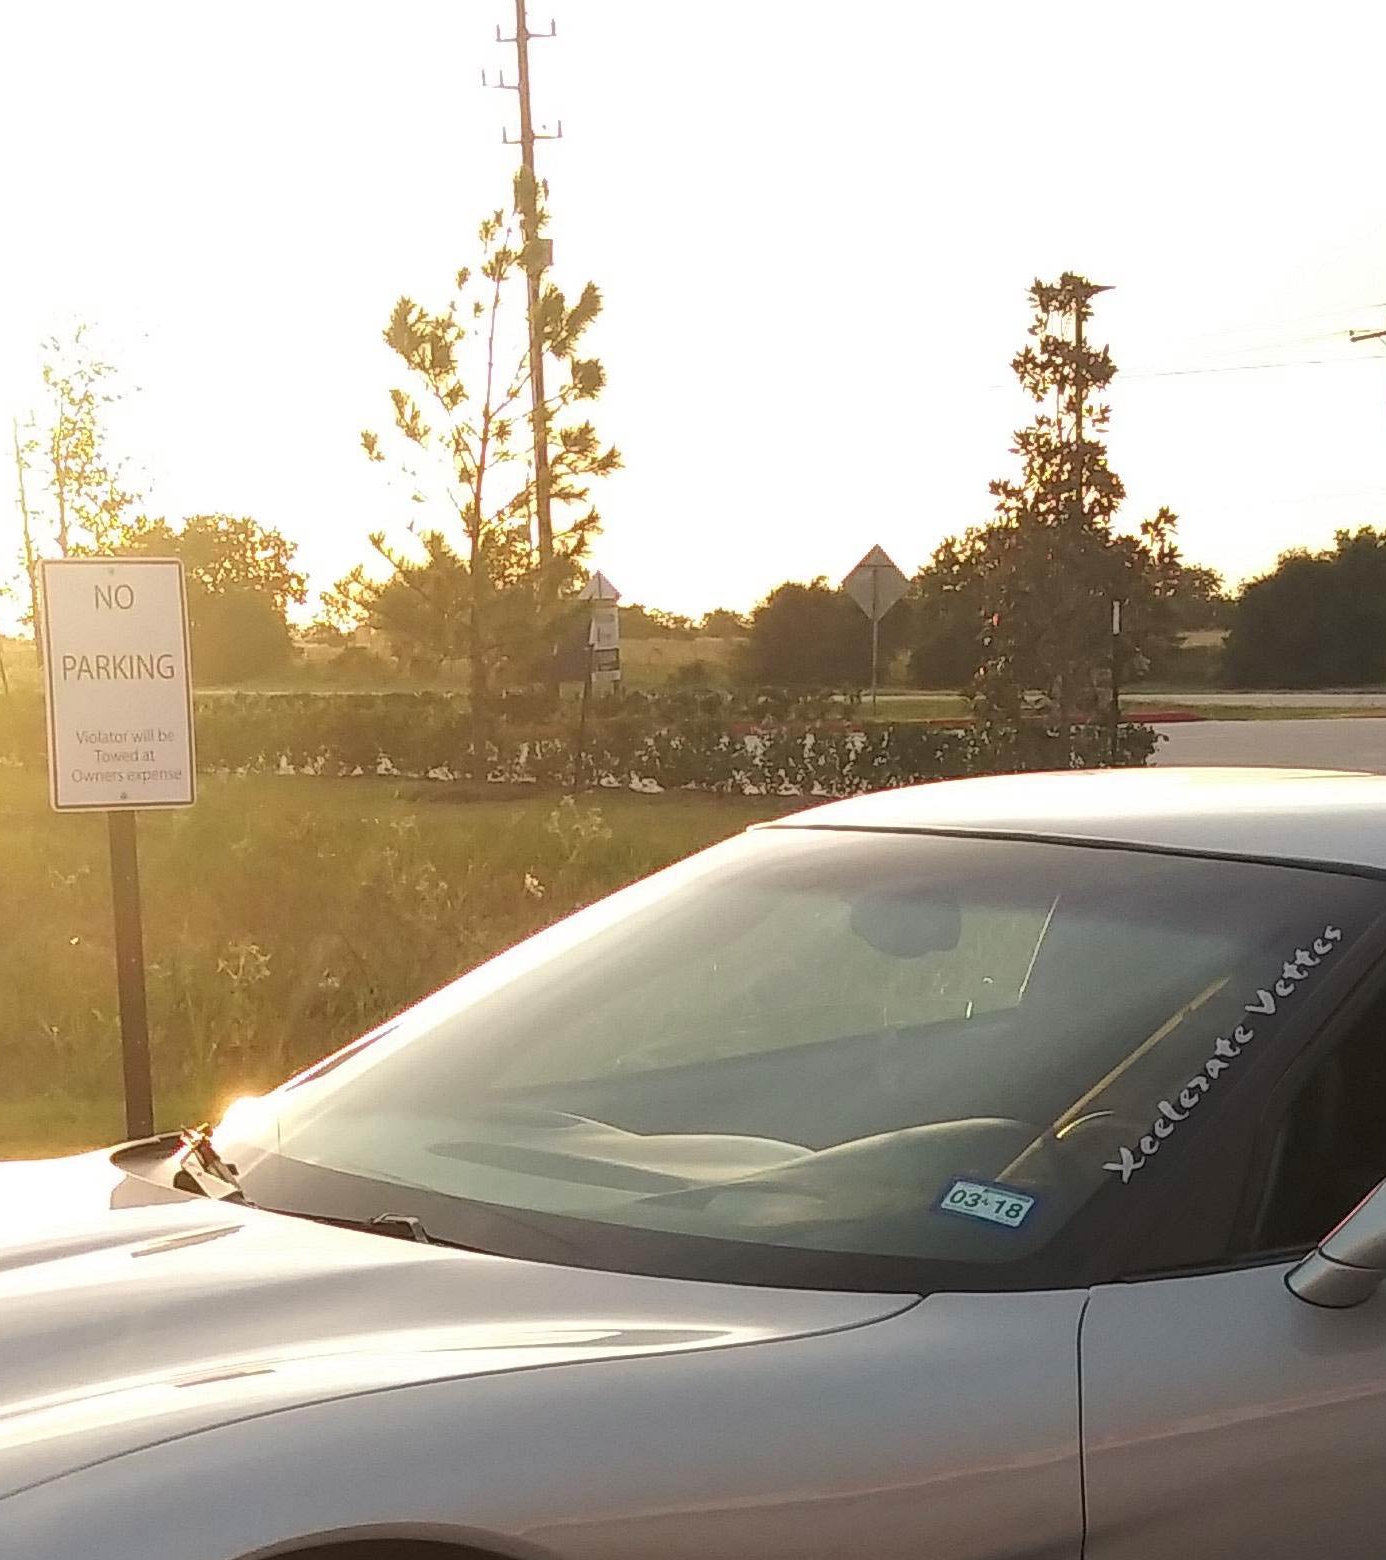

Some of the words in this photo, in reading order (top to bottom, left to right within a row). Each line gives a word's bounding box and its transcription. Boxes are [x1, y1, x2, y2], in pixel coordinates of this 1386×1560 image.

[94, 583, 135, 611] NO
[62, 653, 176, 681] PARKING
[75, 730, 128, 745] Violator
[132, 729, 154, 743] will
[158, 729, 175, 743] be
[94, 749, 139, 763] Towed
[142, 750, 156, 763] at
[71, 768, 124, 784] Owners
[126, 768, 183, 785] expense
[1244, 924, 1343, 1016] Vettes
[949, 1189, 982, 1208] 03
[994, 1199, 1024, 1219] 18
